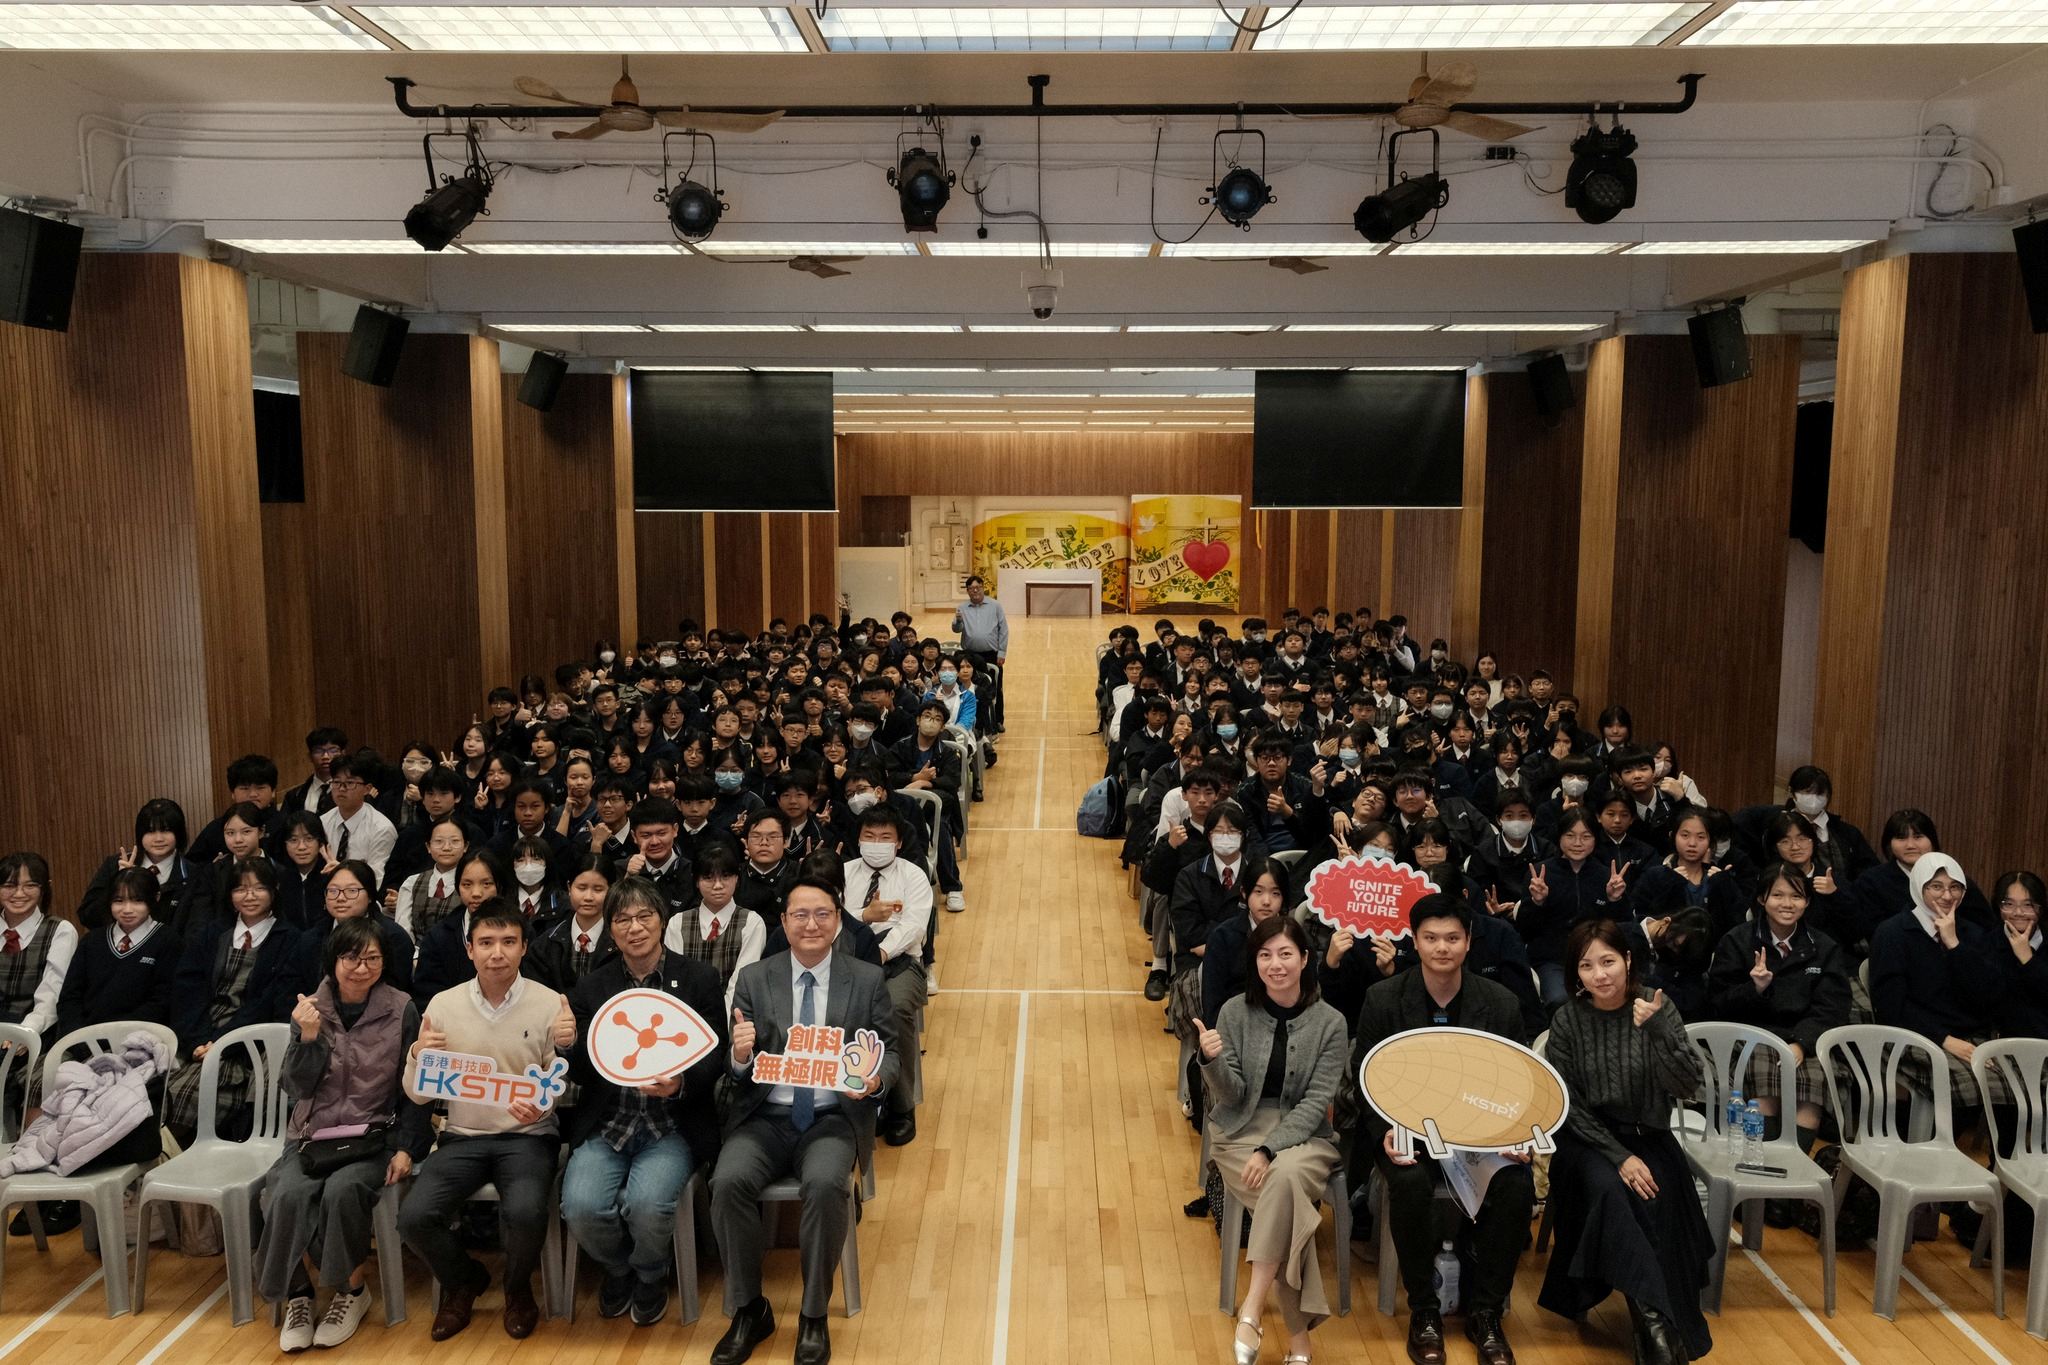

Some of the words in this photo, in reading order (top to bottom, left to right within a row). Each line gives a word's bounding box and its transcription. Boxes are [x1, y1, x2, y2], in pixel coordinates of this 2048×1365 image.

[1134, 554, 1184, 585] LOVE
[1349, 878, 1403, 896] IGNITE
[1353, 890, 1397, 906] YOUR
[1346, 901, 1400, 918] FUTURE
[787, 1026, 843, 1056] 創科
[422, 1054, 492, 1075] 香港科技園
[752, 1054, 839, 1088] 無極限
[417, 1068, 537, 1104] HKSTP
[1462, 1092, 1509, 1115] HKSTP
